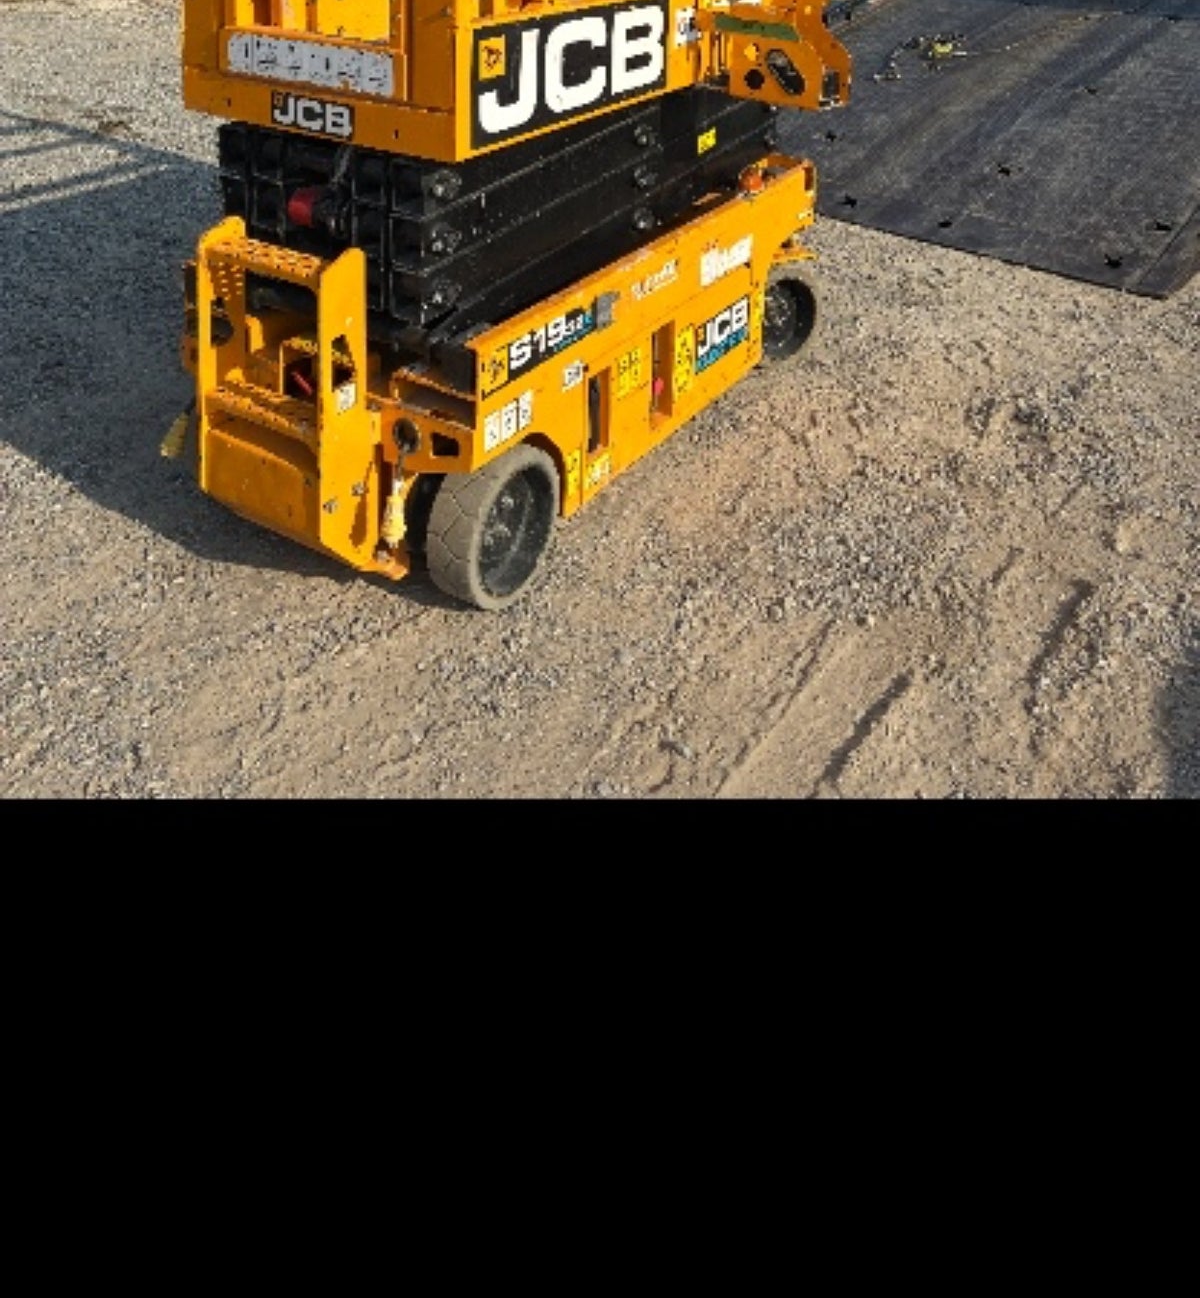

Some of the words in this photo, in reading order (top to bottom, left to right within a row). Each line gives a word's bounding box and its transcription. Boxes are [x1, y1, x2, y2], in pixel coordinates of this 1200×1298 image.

[478, 4, 666, 134] JCB
[273, 95, 353, 138] JCB
[697, 297, 749, 358] JCB
